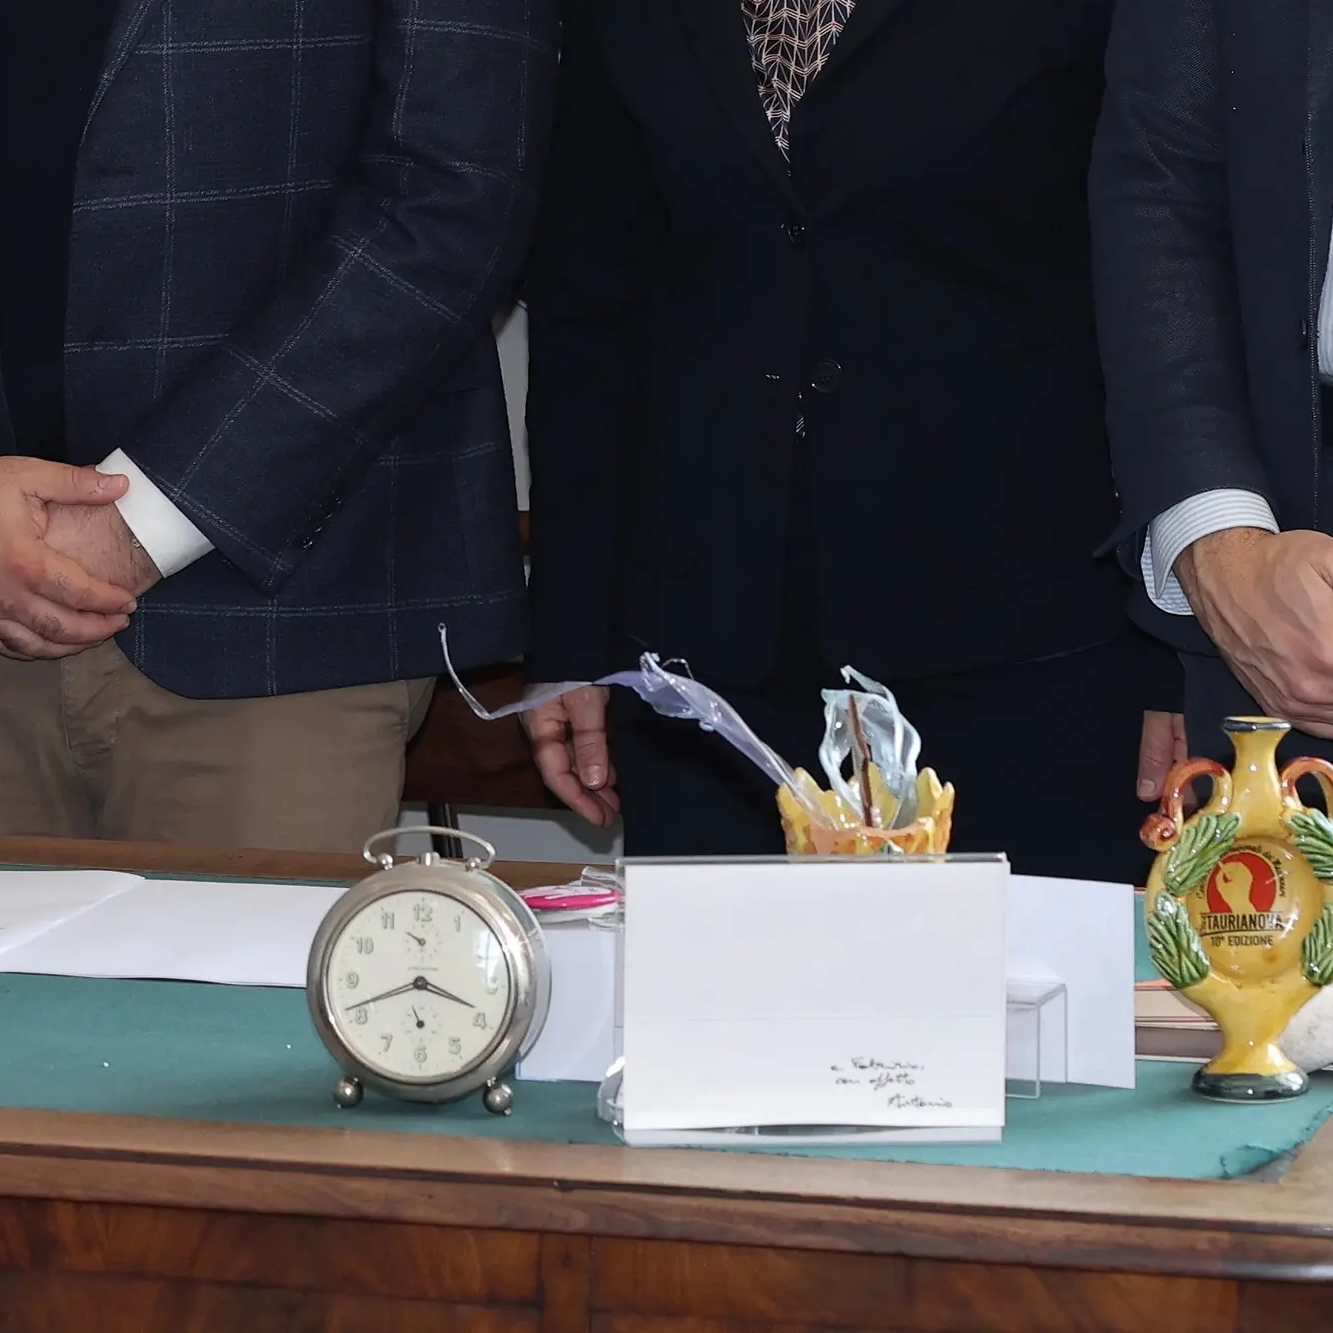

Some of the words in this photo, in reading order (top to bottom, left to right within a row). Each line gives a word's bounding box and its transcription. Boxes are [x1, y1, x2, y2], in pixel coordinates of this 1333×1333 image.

[381, 912, 396, 930] 11
[413, 904, 433, 922] 12
[357, 937, 374, 955] 10
[1228, 935, 1274, 946] EDIZIONE
[346, 972, 359, 989] 9
[355, 1007, 368, 1025] 8
[472, 1012, 487, 1030] 4
[380, 1033, 393, 1052] 7
[449, 1037, 461, 1055] 5
[414, 1046, 427, 1063] 6
